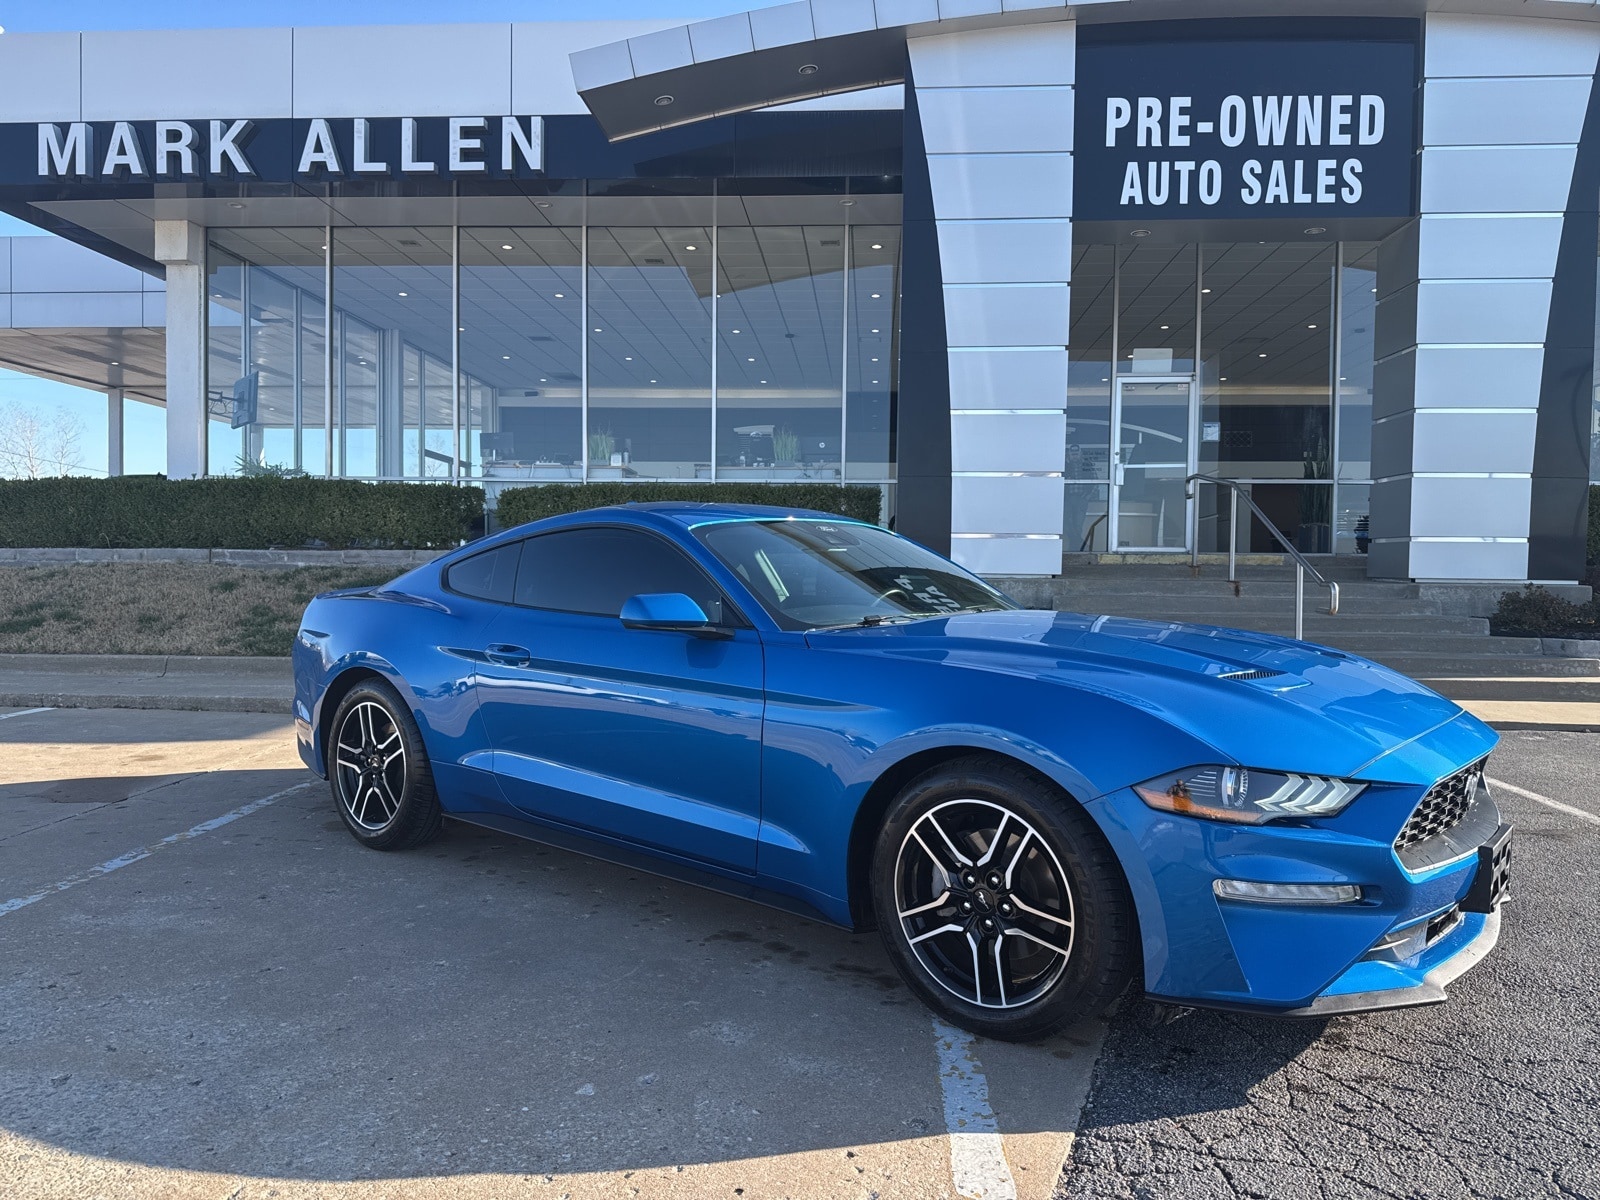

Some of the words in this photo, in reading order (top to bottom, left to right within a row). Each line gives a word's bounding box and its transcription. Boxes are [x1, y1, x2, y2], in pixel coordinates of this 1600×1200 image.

[38, 120, 253, 176] MARK
[298, 118, 544, 173] ALLEN
[1106, 95, 1384, 147] PRE-OWNED
[1120, 160, 1221, 205] AUTO
[1241, 159, 1362, 204] SALES
